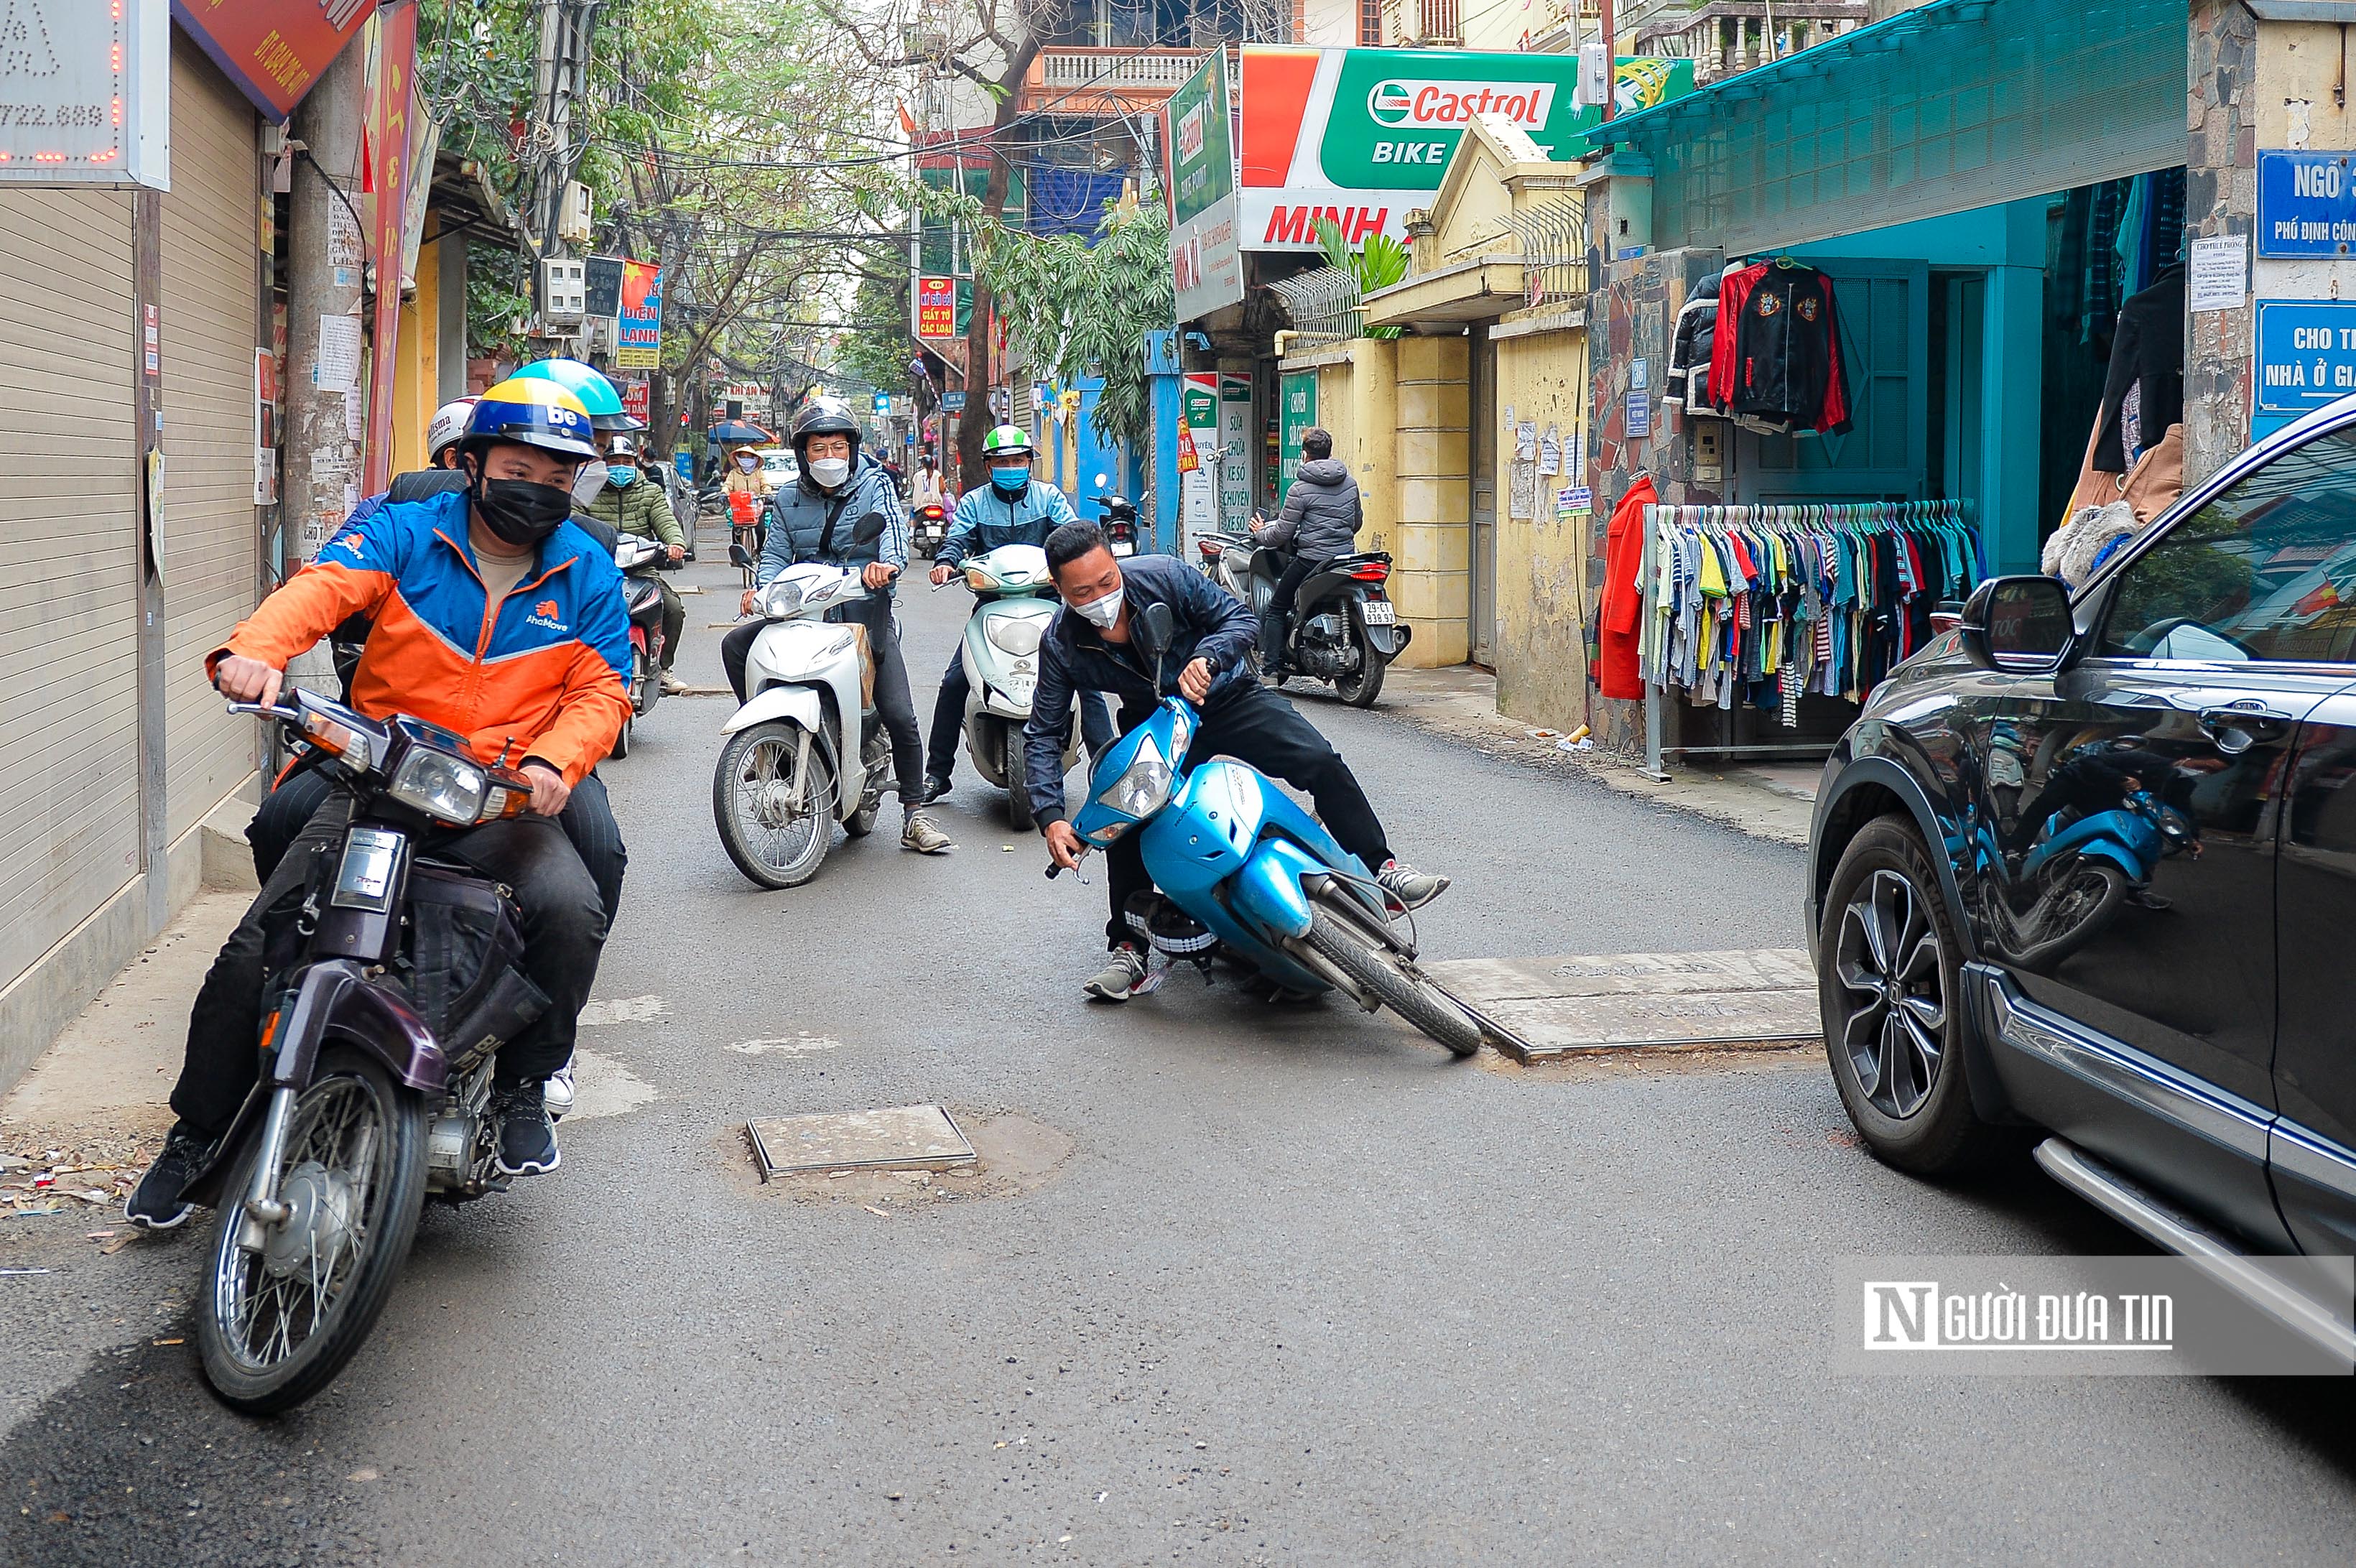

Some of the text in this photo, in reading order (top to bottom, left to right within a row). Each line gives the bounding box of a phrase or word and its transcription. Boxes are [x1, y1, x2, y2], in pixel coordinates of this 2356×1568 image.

[1414, 85, 1540, 134] Castrol
[1183, 110, 1202, 157] Castrol
[1371, 142, 1446, 164] BIKE
[2294, 160, 2339, 198] NGÕ
[1263, 205, 1388, 243] MINH
[2275, 215, 2299, 240] PHỐ
[2301, 221, 2329, 243] ĐỊNH
[2209, 241, 2223, 250] THUÊ
[921, 290, 952, 306] KÝ GỬI ĐỒ
[623, 302, 657, 323] ĐIỆN
[922, 307, 951, 320] GIẤY TỜ
[621, 328, 658, 346] LẠNH
[920, 321, 952, 336] CÁC LOẠI
[2294, 327, 2332, 350] CHO
[1634, 364, 1643, 384] 36
[2265, 359, 2305, 386] NHÀ
[2314, 357, 2327, 386] Ở
[547, 404, 578, 426] be
[1229, 411, 1243, 432] SỬA
[1194, 440, 1212, 450] HUYÊN
[1228, 438, 1245, 456] CHỮA
[1227, 462, 1246, 481] XE SỐ
[1223, 488, 1249, 506] CHUYÊN
[1227, 513, 1246, 532] XE SỐ
[1367, 603, 1389, 613] 29-C1
[526, 615, 568, 631] AhaMove
[1367, 613, 1394, 623] 838.92
[1173, 800, 1198, 828] HONDA
